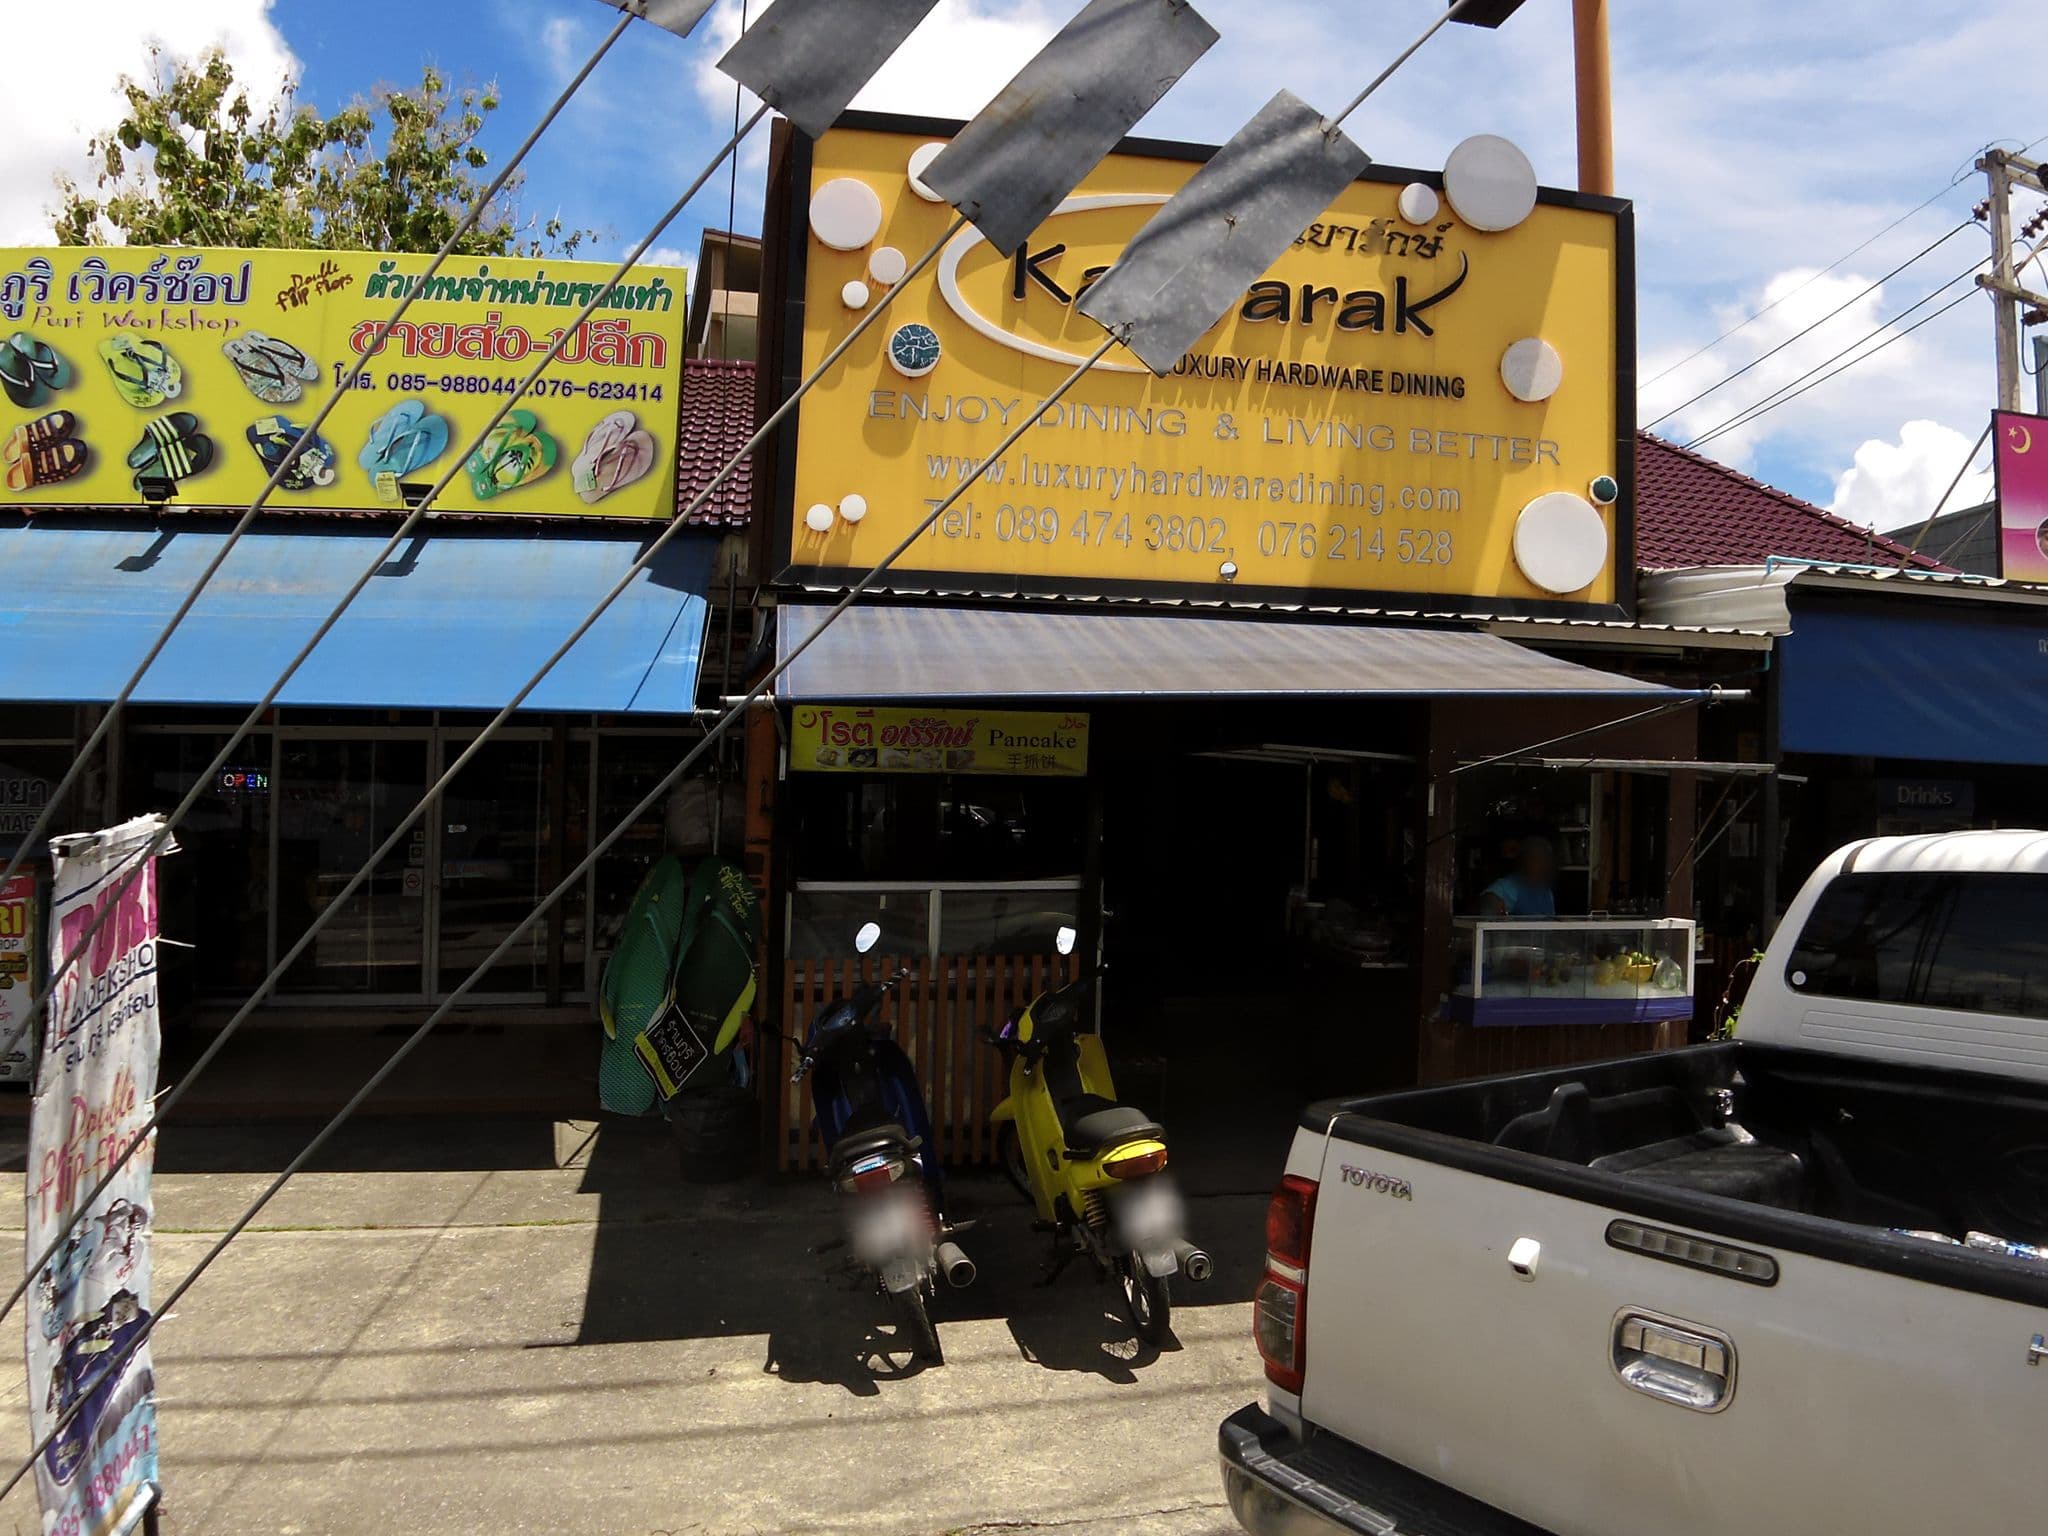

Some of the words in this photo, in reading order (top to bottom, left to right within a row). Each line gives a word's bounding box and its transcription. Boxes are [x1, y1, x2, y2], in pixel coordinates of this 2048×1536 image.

[0, 256, 53, 320] ภูริ
[31, 305, 84, 328] Puri
[103, 307, 240, 337] Workshop
[1172, 353, 1251, 380] UXURY
[1256, 358, 1384, 394] HARDWARE
[1390, 371, 1465, 400] DINING
[868, 389, 1020, 427] ENJOY
[1036, 398, 1188, 437] DINING
[1213, 412, 1239, 442] &
[1263, 417, 1396, 452] LIVING
[1409, 427, 1561, 467] BETTER
[927, 453, 1461, 516] www.luxuryhardwaredining.com
[924, 498, 982, 540] Tel:
[995, 503, 1060, 545] 089
[1070, 509, 1132, 549] 474
[1145, 513, 1235, 558] 3802,
[1258, 520, 1318, 559] 076
[1328, 523, 1386, 562] 214
[1396, 528, 1454, 566] 528
[820, 708, 875, 747] โรตี
[988, 729, 1078, 750] Pancake
[224, 773, 268, 789] OPEN
[1896, 785, 1953, 805] Drinks
[0, 814, 39, 831] MAC
[1340, 1163, 1413, 1202] TOYOTA
